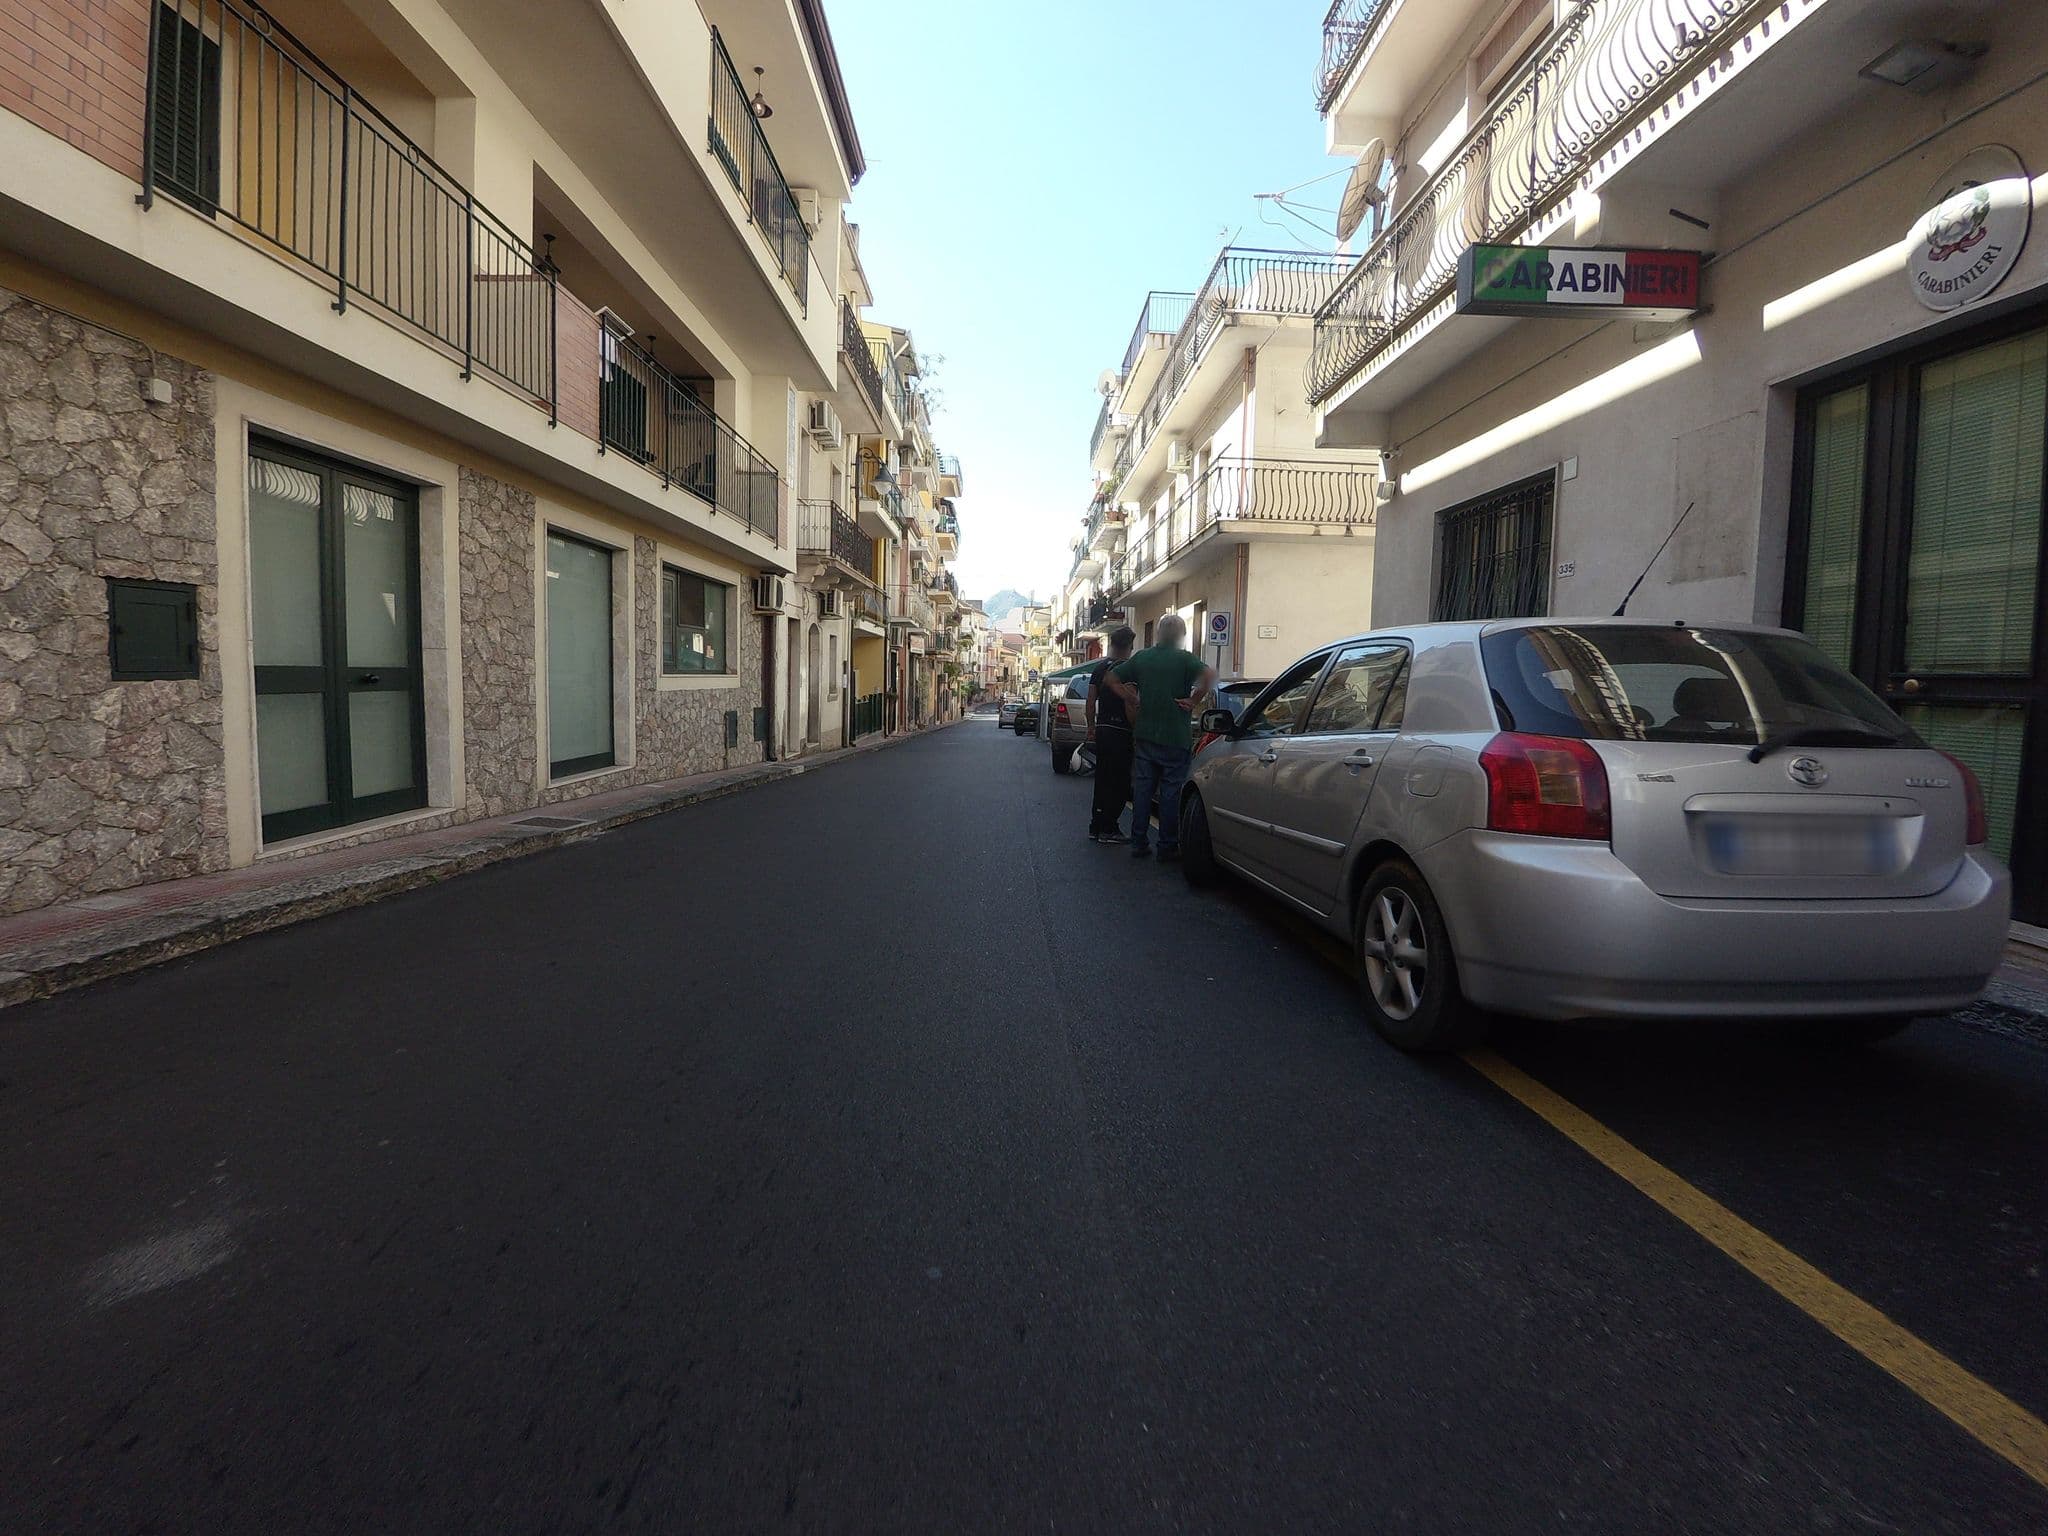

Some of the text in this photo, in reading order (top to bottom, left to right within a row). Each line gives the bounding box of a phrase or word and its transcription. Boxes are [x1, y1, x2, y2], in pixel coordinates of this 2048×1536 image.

[1485, 259, 1689, 295] CARABINIERI
[1917, 244, 2002, 294] CARABINIERI
[1559, 563, 1574, 575] 335
